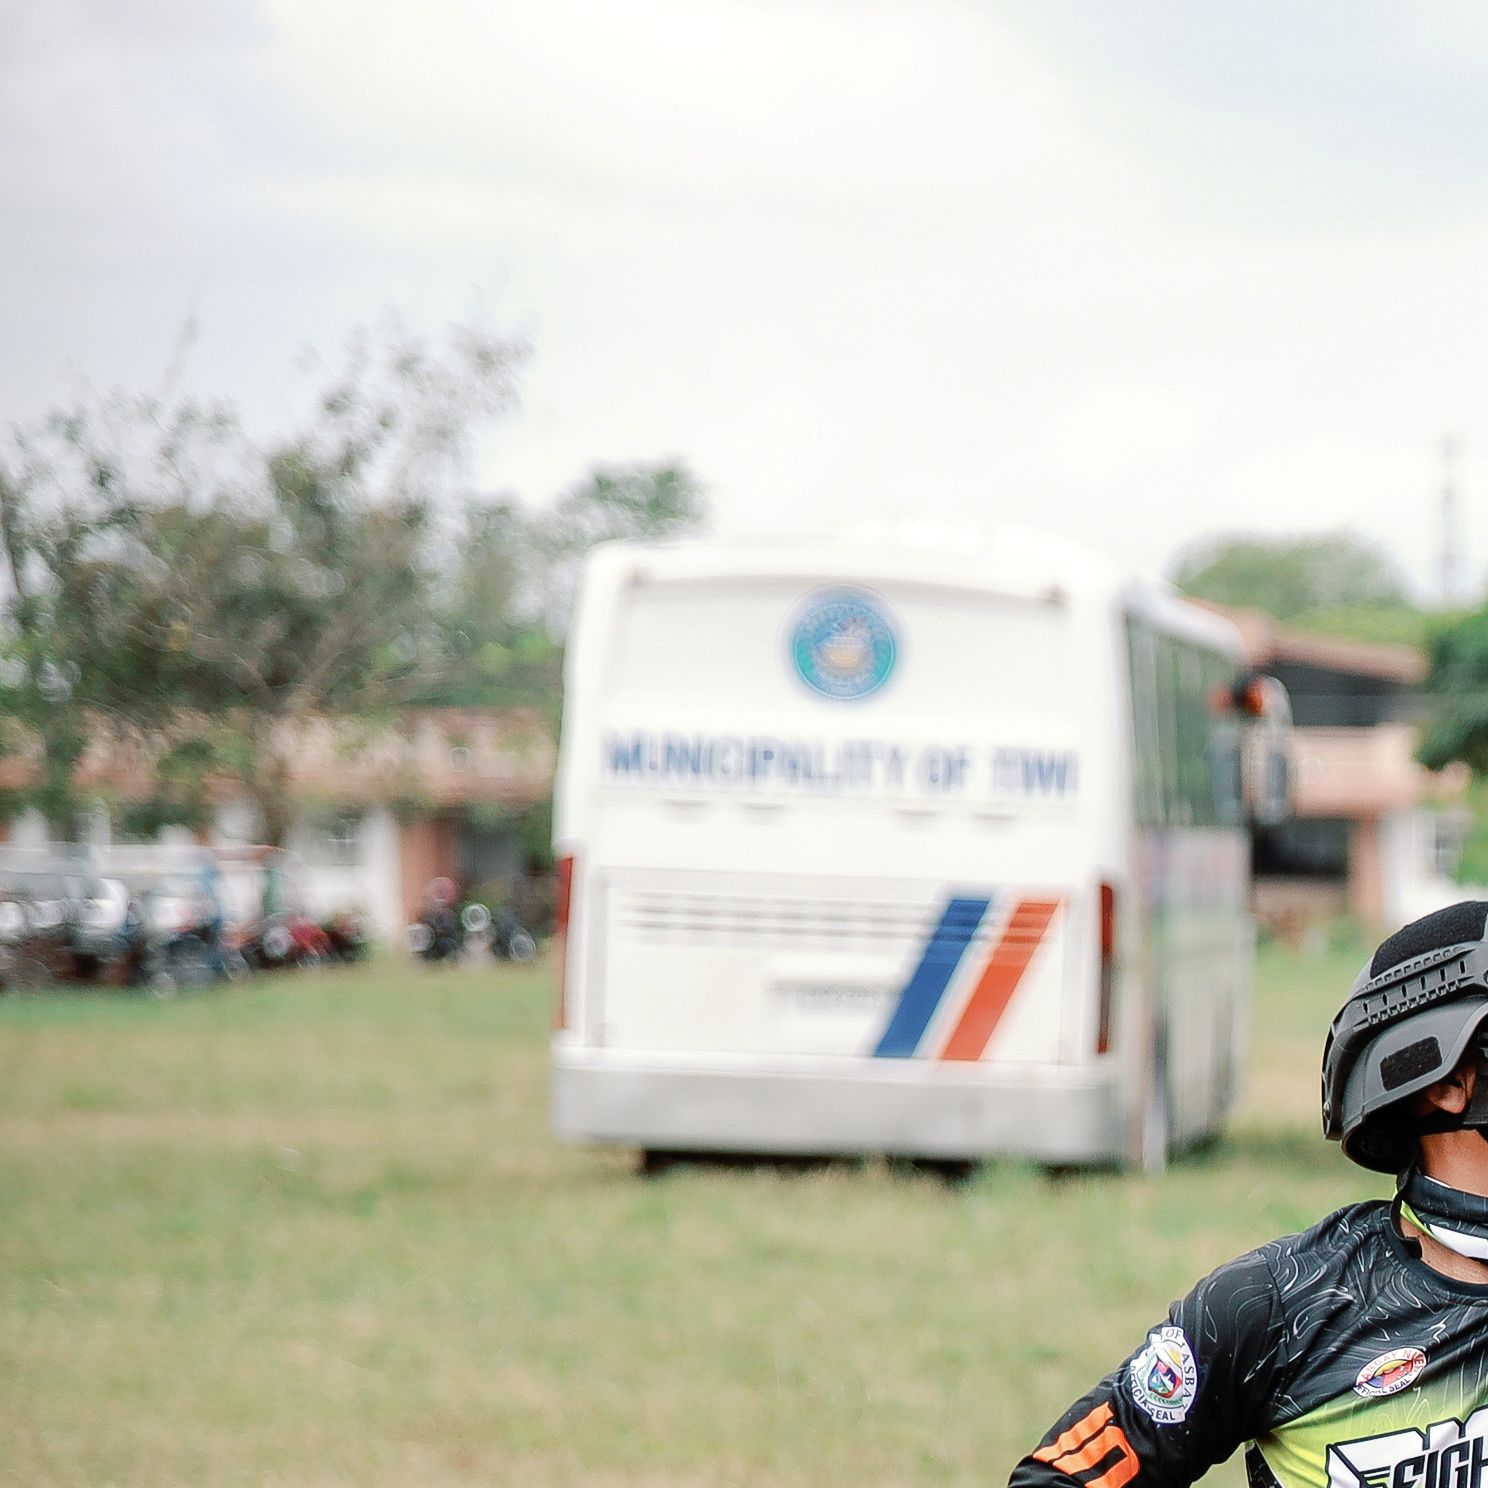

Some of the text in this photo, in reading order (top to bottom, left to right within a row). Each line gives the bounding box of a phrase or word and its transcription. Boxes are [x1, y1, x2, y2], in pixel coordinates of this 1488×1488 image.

[922, 746, 971, 791] OF
[1165, 1329, 1182, 1339] OF
[1388, 1378, 1412, 1393] SEAL
[1150, 1408, 1176, 1421] SEAL
